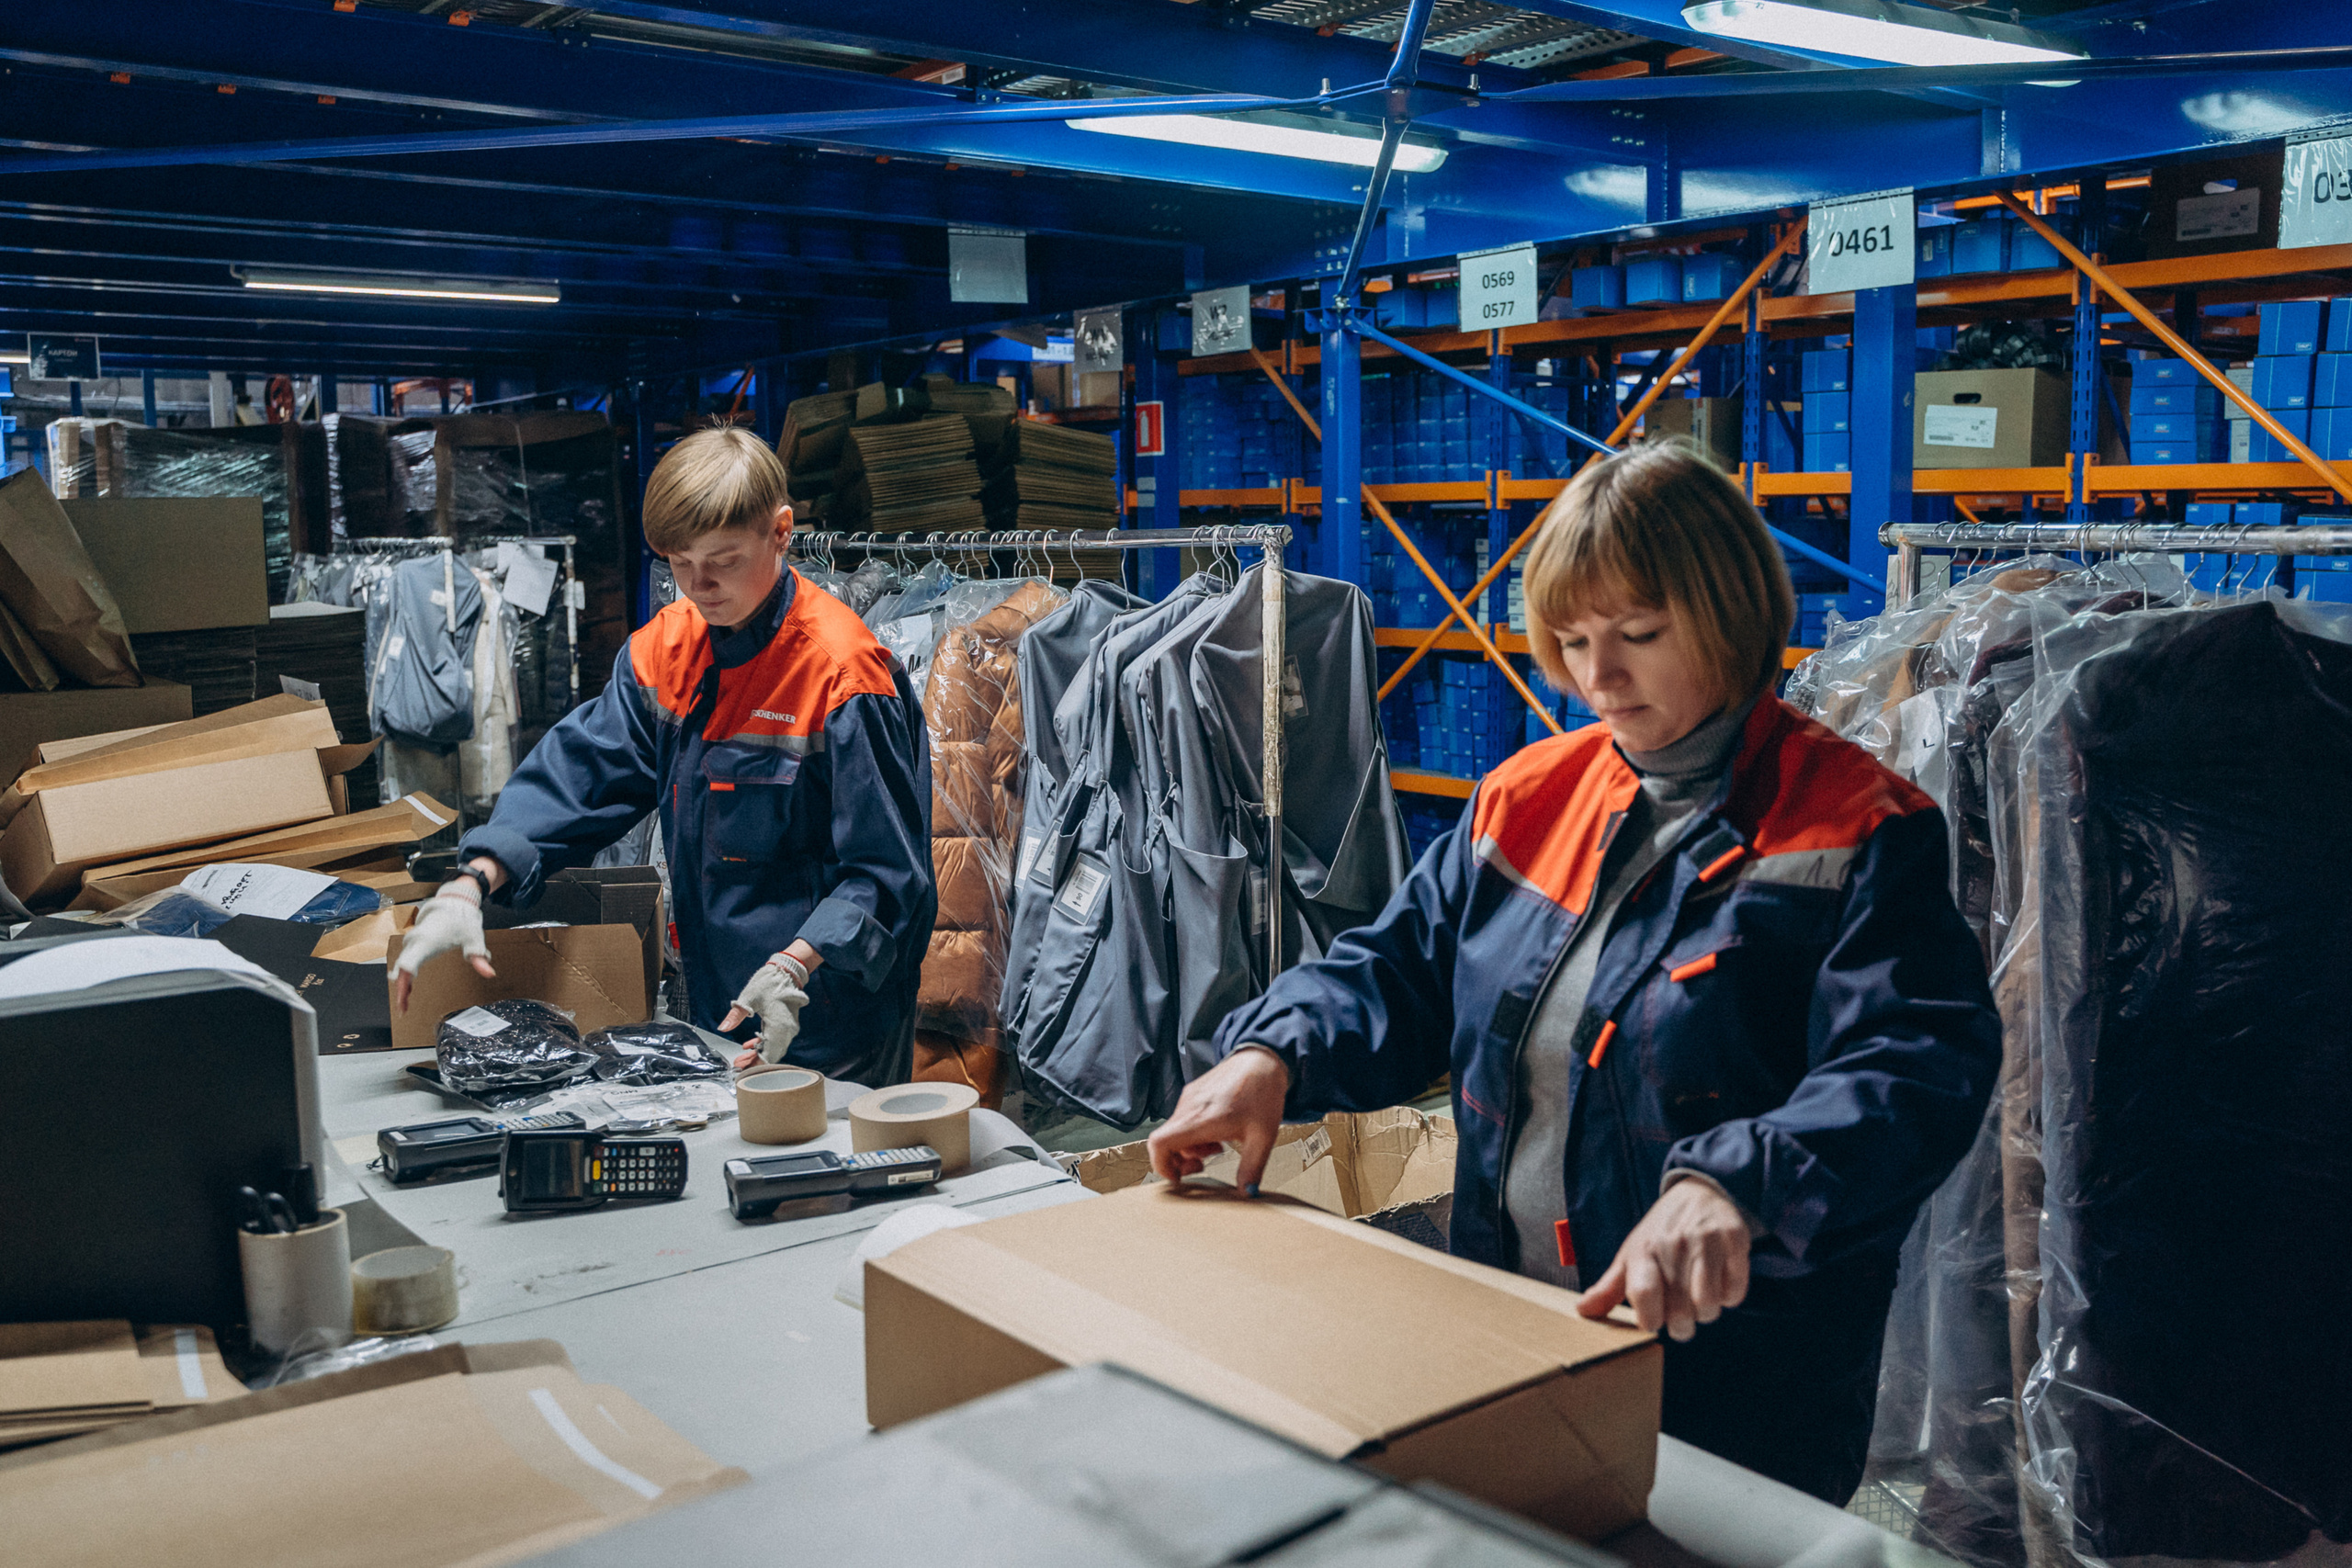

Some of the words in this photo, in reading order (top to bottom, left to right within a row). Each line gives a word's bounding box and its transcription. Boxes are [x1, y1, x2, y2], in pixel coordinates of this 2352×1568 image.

[1828, 224, 1894, 257] 0461
[1482, 270, 1515, 289] 0569
[1482, 300, 1515, 319] 0577
[754, 709, 797, 725] SCHENKER
[1922, 738, 1936, 749] L
[655, 860, 667, 870] XS
